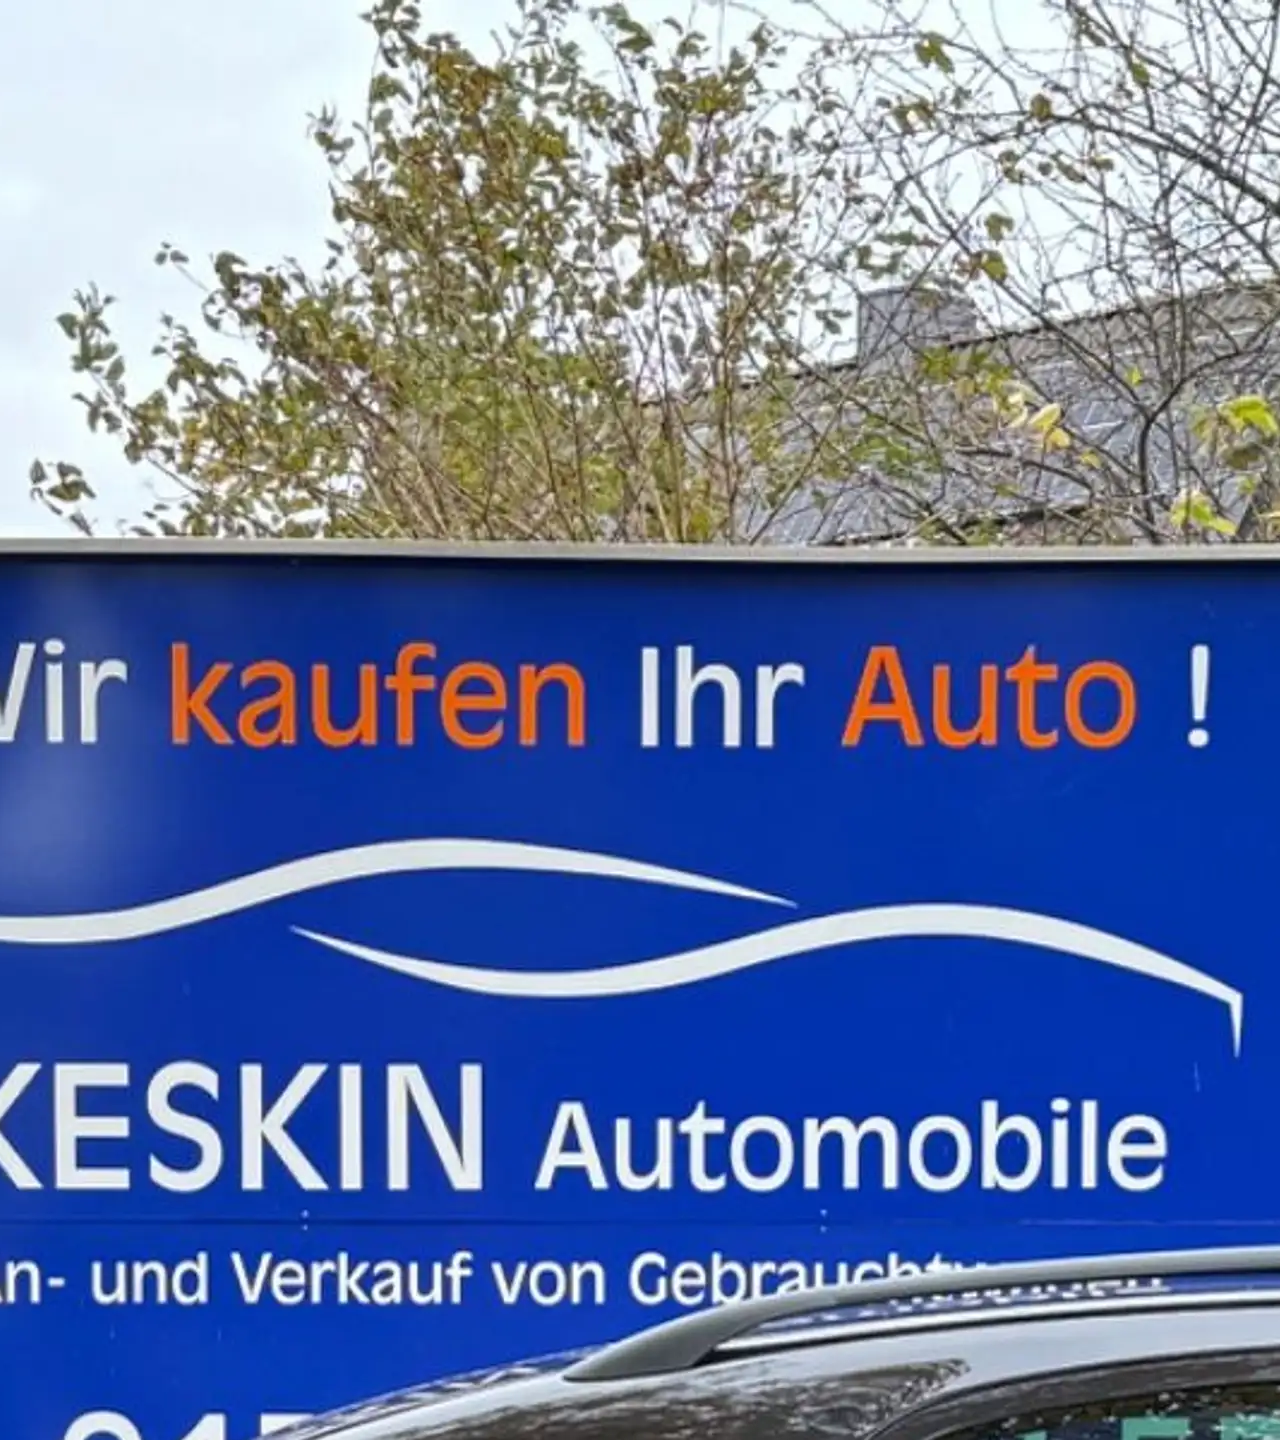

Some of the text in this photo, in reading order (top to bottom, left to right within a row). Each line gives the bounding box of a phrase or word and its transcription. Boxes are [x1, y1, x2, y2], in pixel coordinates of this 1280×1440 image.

[170, 641, 586, 750] kaufen
[640, 644, 805, 748] Ihr
[841, 645, 1137, 750] Auto
[1187, 644, 1211, 748] !
[533, 1097, 1168, 1193] Automobile
[91, 1251, 209, 1306] und
[230, 1249, 474, 1306] Verkauf
[490, 1260, 606, 1307] von
